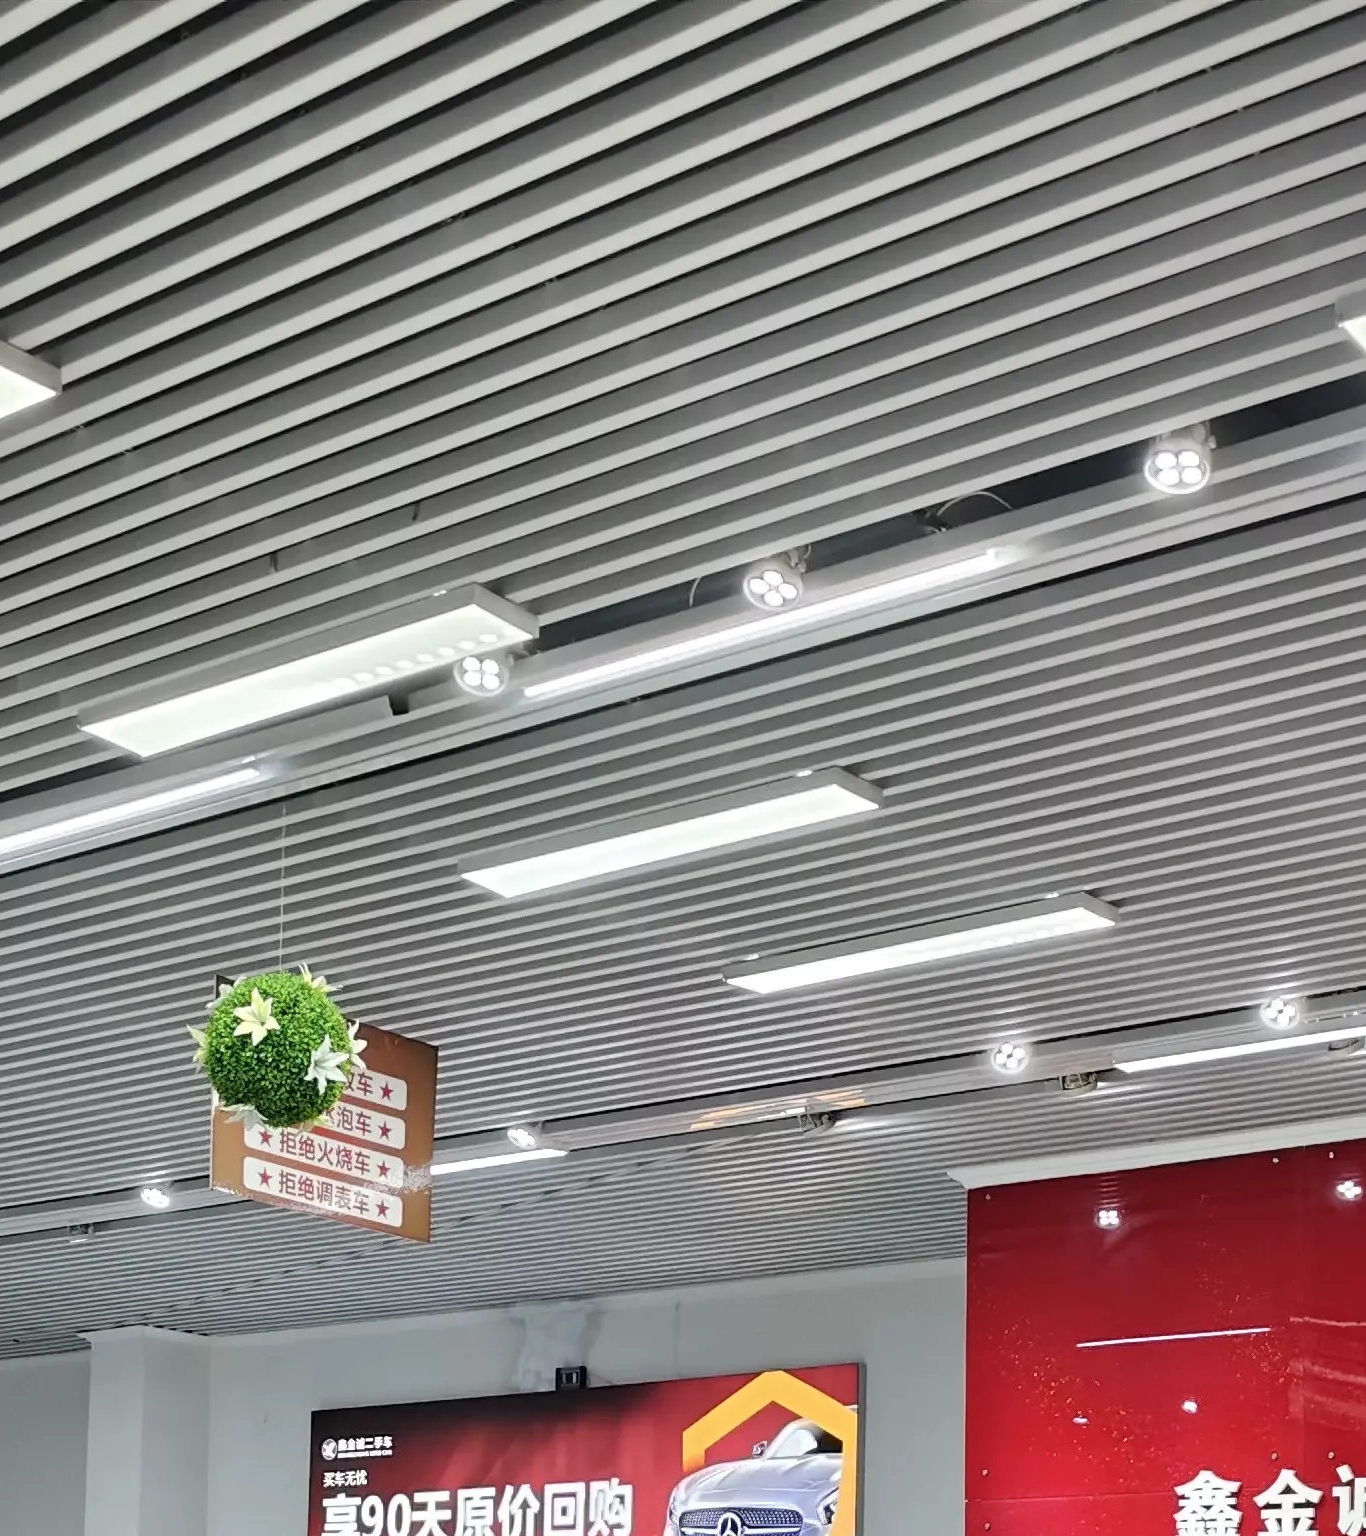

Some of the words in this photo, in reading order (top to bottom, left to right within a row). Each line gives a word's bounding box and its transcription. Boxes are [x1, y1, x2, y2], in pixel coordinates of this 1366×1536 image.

[279, 1130, 371, 1176] 拒绝火烧车
[278, 1169, 370, 1215] 拒绝调表车
[323, 1470, 367, 1487] 买车无忧
